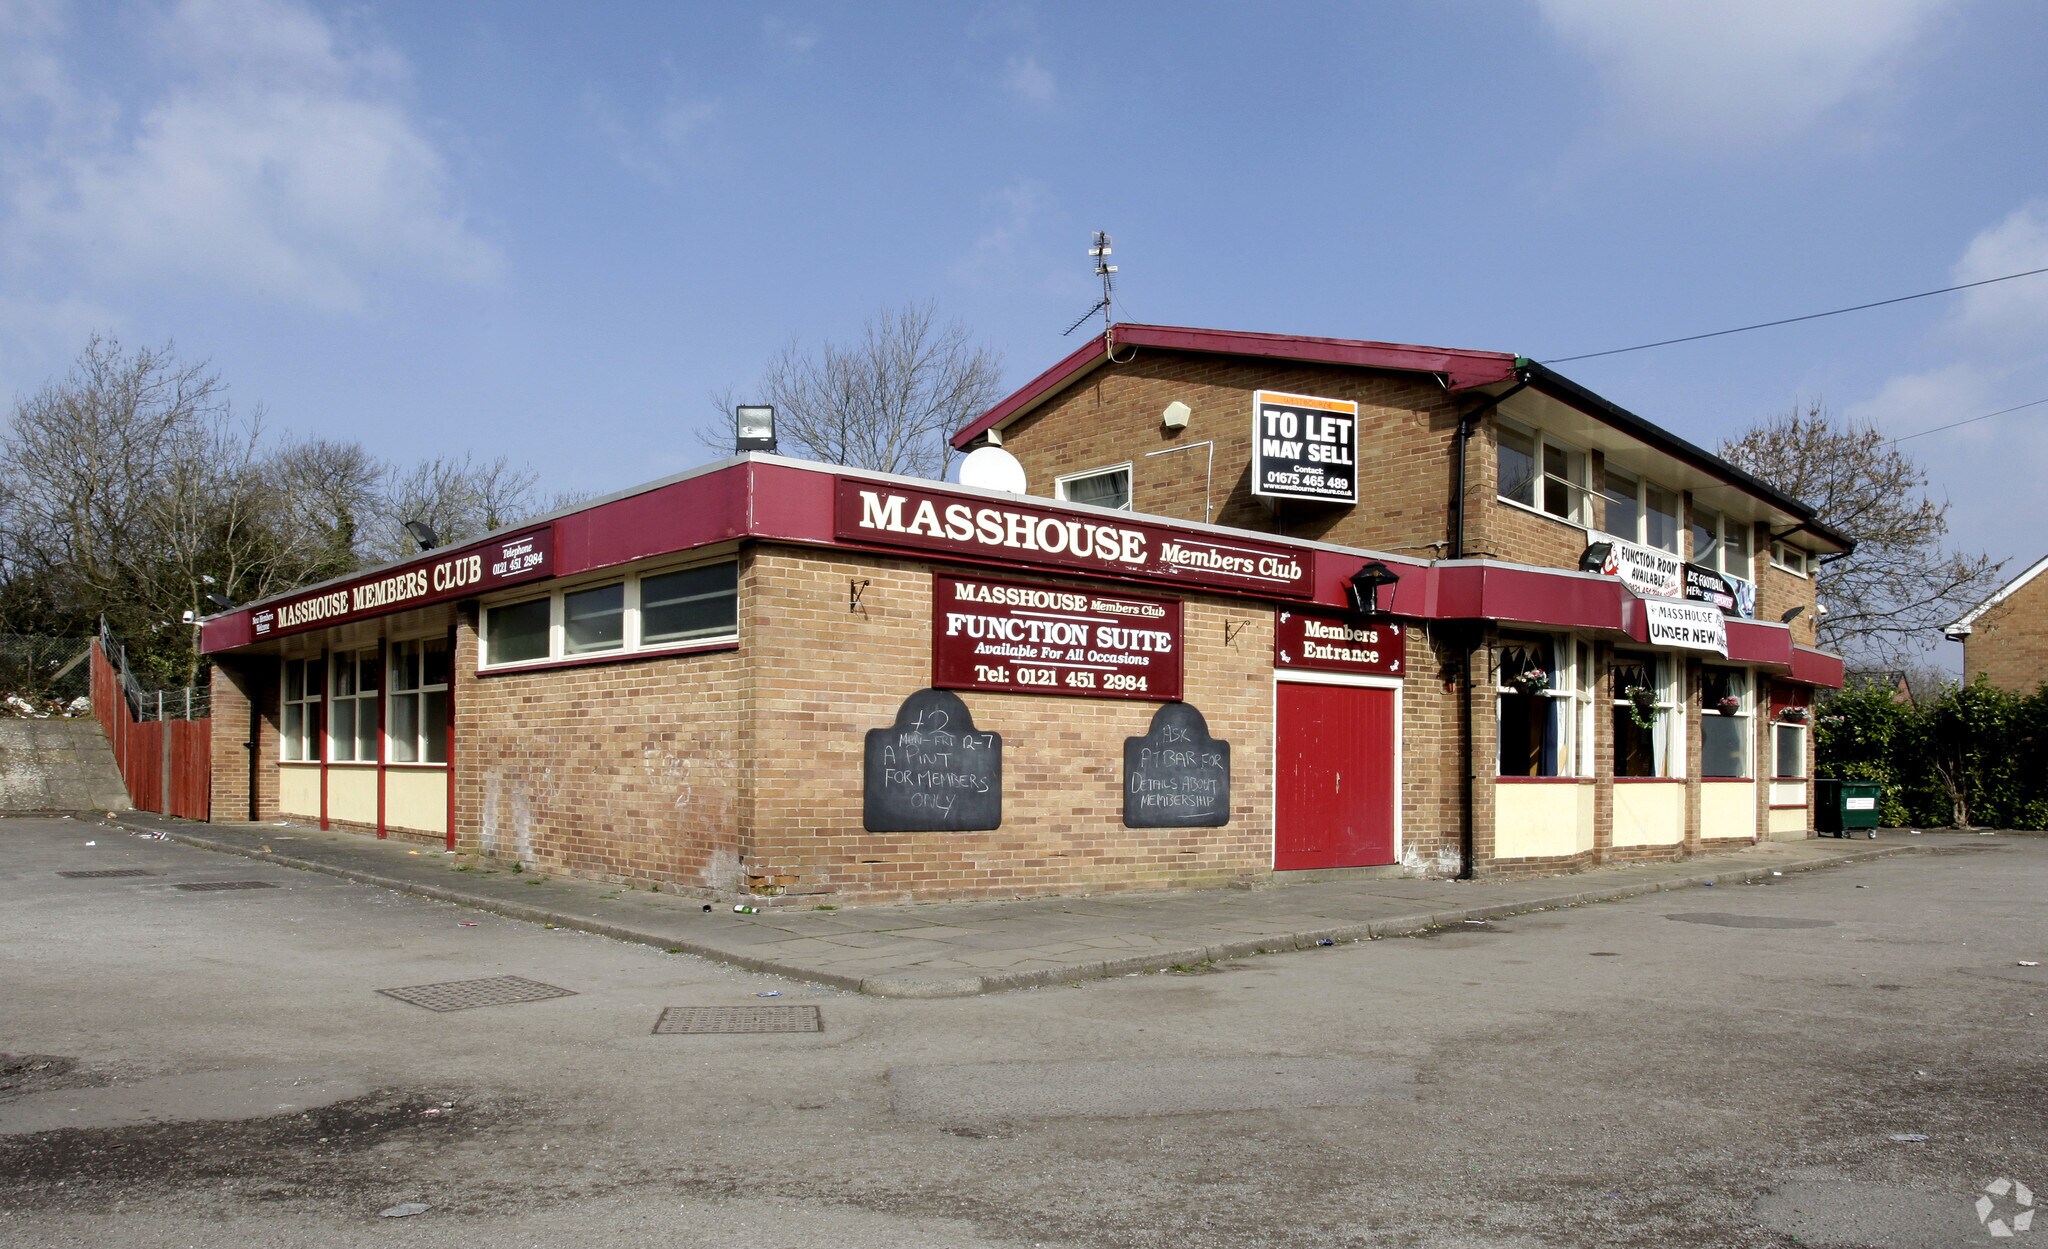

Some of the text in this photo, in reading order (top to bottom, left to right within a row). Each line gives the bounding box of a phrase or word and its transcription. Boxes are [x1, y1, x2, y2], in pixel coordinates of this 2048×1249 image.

[1283, 397, 1333, 410] WESTBOURNE
[1263, 410, 1352, 444] TO LET
[1262, 438, 1352, 465] MAY SELL
[1263, 482, 1353, 497] www.westbourne-leisure.co.uk
[1267, 471, 1348, 490] 01675 465 489
[859, 490, 1302, 581] MASSHOUSE Members Club
[492, 551, 543, 576] 0121 451 2984
[502, 544, 533, 560] Telephone
[1621, 546, 1656, 570] FUNCTION
[1657, 557, 1678, 577] ROOM
[1631, 566, 1666, 588] AVAILABLE
[1699, 574, 1725, 593] FOOTBALL
[277, 555, 482, 629] MASSHOUSE MEMBERS CLUB
[955, 582, 1166, 618] MASSHOUSE Members Club
[1703, 591, 1714, 602] SKY
[1713, 594, 1733, 607] SPORTS
[1658, 606, 1713, 624] MASSHOUSE
[946, 612, 1172, 653] FUNCTION SUITE
[1304, 620, 1379, 644] Members
[1651, 623, 1690, 642] UNDER
[1692, 628, 1716, 645] NEW
[974, 642, 1150, 667] Available For All Occasions
[1303, 641, 1379, 664] Entrance
[974, 664, 1149, 692] Tel: 0121 451 2984
[1162, 724, 1192, 743] ASK
[883, 744, 952, 768] A PINT
[1141, 746, 1224, 770] AT BAR FOR
[884, 768, 989, 793] FOR MEMBERS
[1131, 771, 1217, 796] DETAILS ABOUT
[910, 792, 956, 820] ONLY
[1140, 793, 1215, 809] MEMBERSHIP
